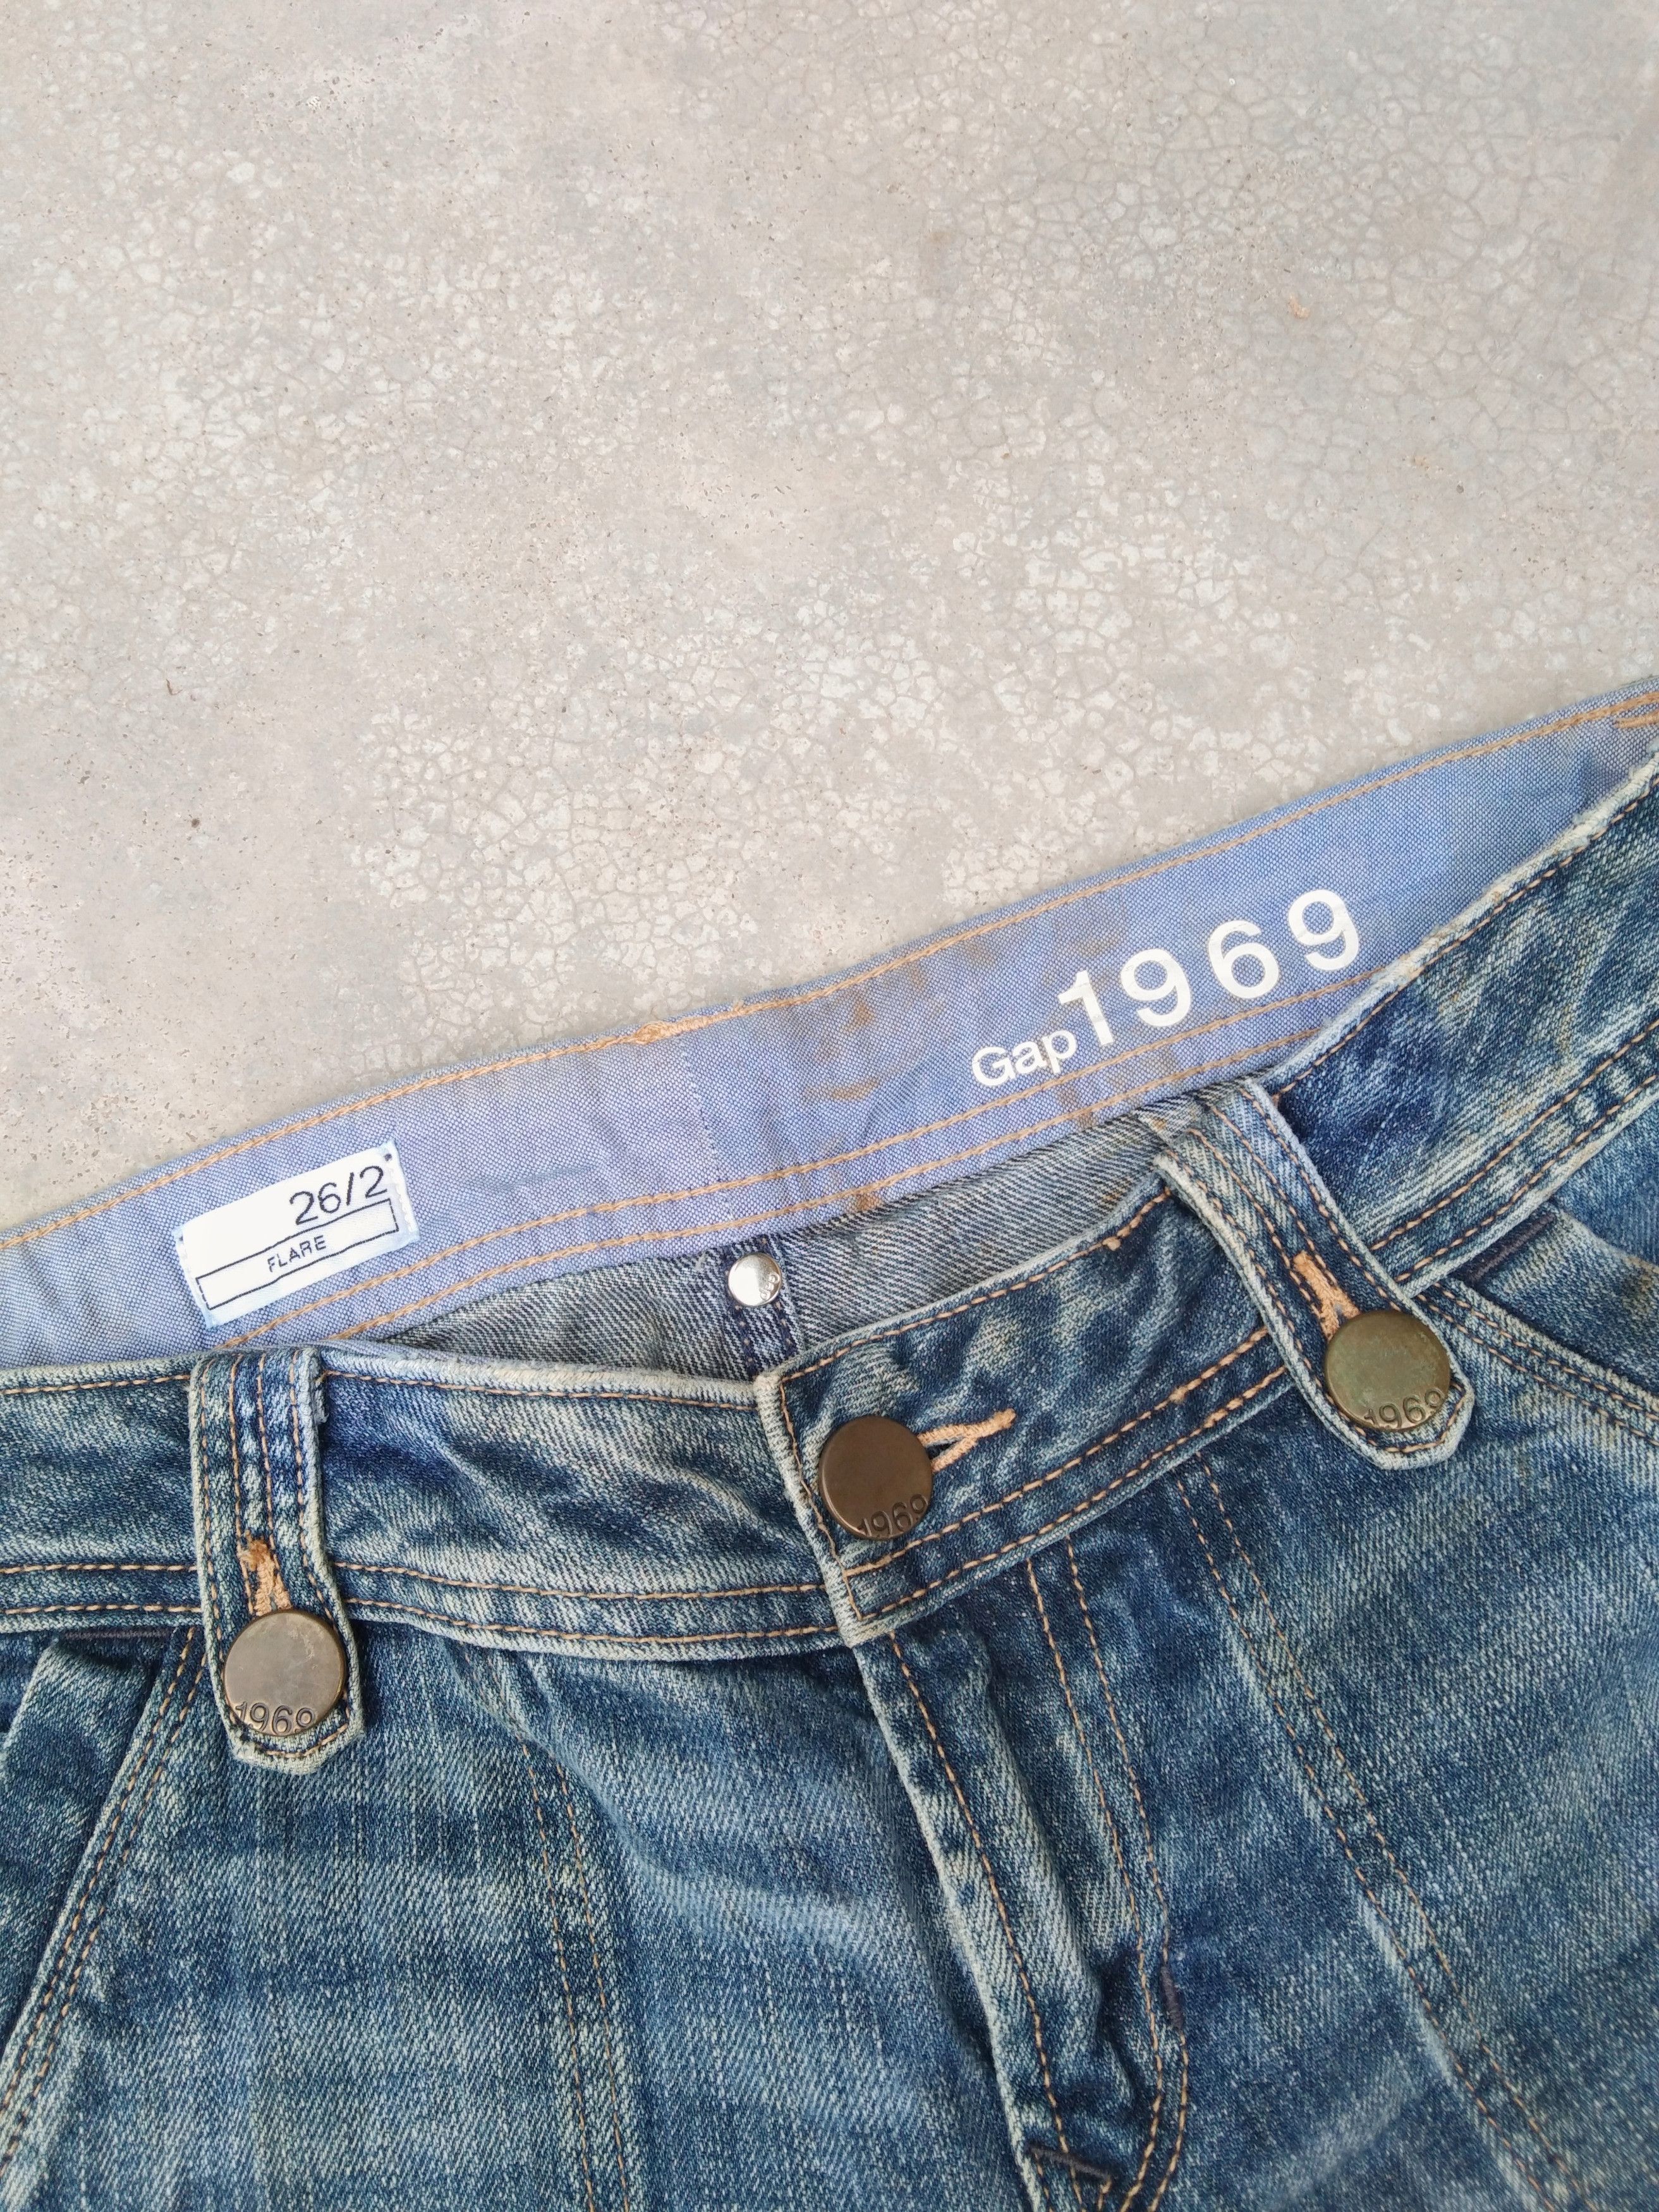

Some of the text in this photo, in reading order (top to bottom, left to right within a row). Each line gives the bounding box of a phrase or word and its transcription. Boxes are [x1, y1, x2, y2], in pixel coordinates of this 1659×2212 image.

[971, 889, 1360, 1086] Gap 1969
[289, 1165, 387, 1226] 26/2
[267, 1235, 327, 1273] FLARE
